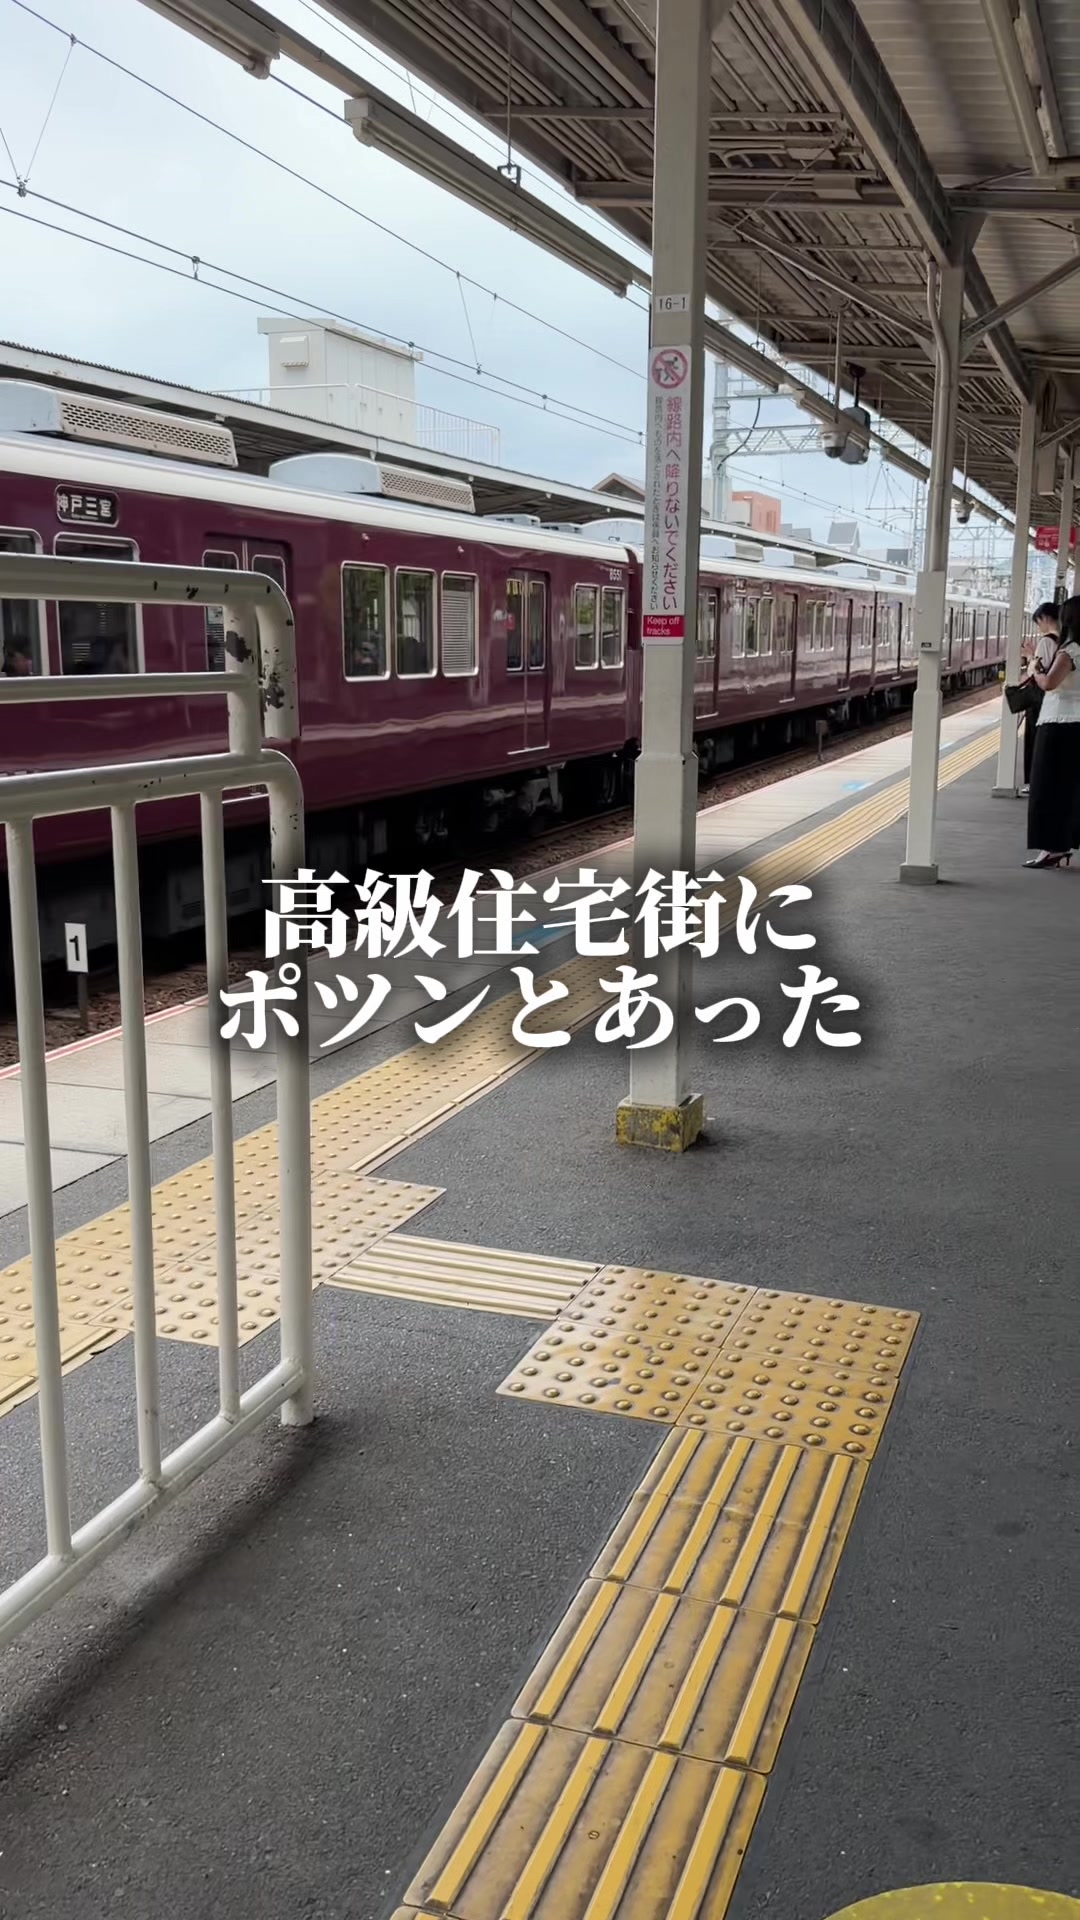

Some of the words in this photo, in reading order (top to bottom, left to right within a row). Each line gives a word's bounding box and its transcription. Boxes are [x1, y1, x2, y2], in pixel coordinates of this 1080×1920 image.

[658, 296, 686, 310] 16-1
[56, 492, 112, 518] 神戸三宮
[662, 396, 683, 610] 線路内へ降りないでください
[646, 627, 671, 635] tracks
[647, 616, 668, 628] Keep
[668, 616, 680, 625] off
[69, 935, 80, 961] 1
